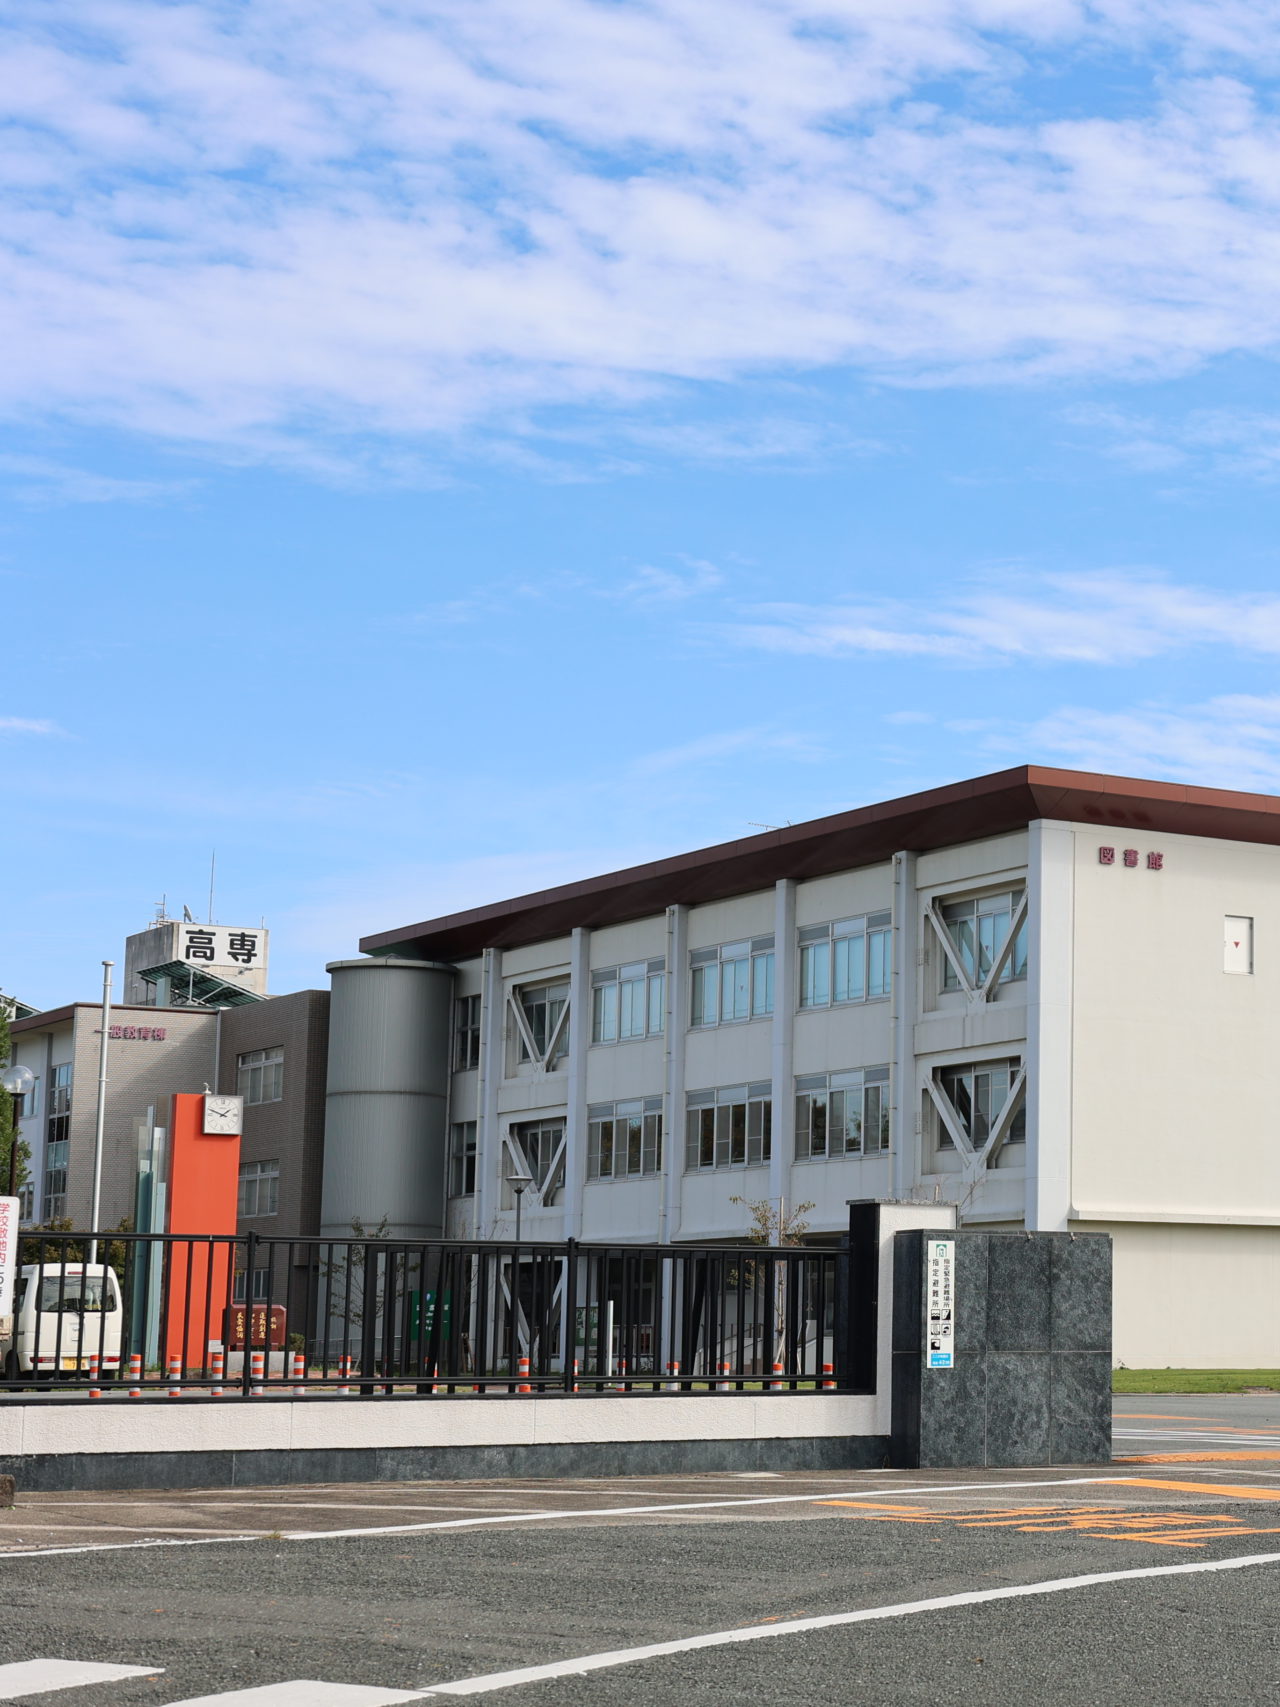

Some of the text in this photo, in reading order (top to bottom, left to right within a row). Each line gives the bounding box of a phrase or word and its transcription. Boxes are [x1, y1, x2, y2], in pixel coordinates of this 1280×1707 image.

[1099, 846, 1164, 870] 図書館
[185, 929, 258, 964] 高専
